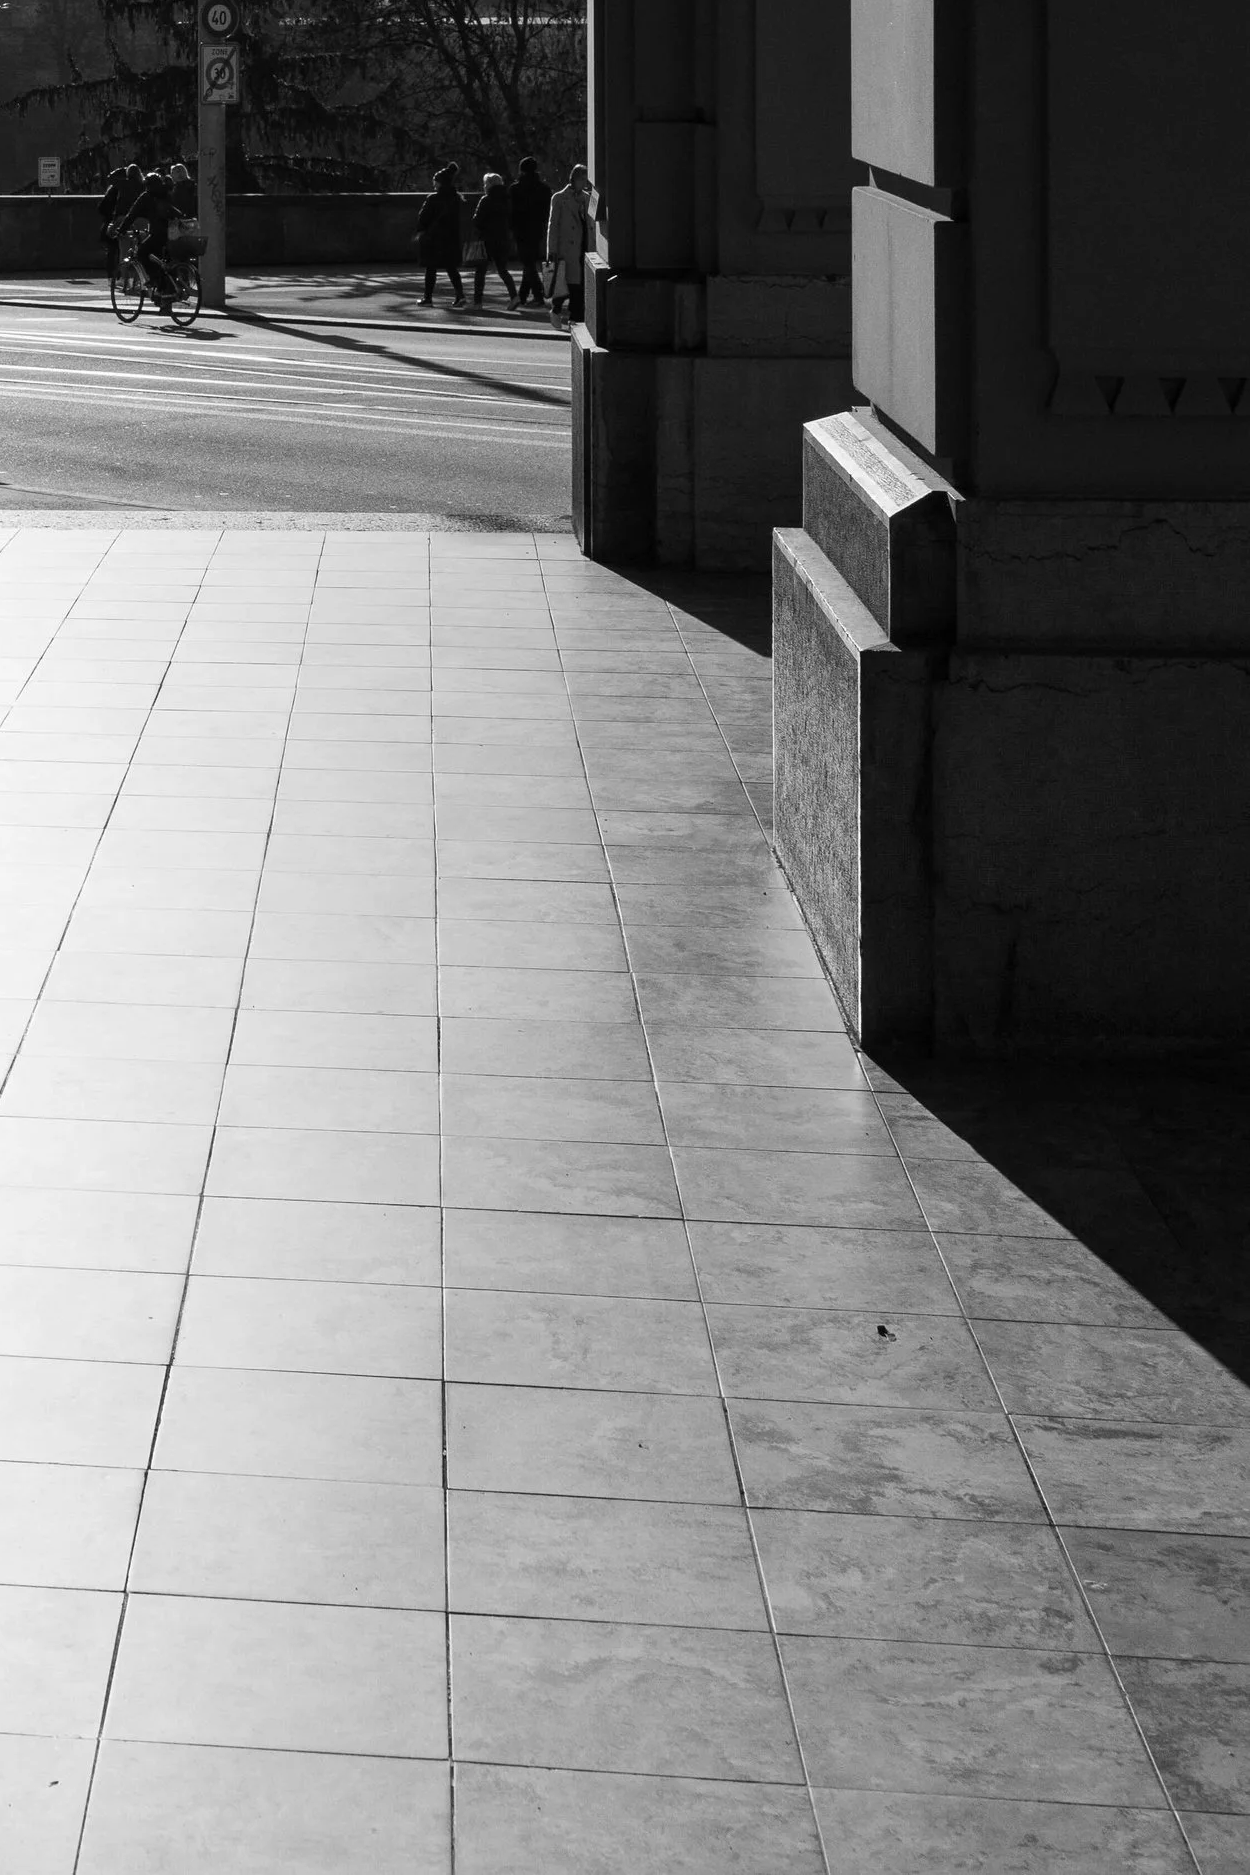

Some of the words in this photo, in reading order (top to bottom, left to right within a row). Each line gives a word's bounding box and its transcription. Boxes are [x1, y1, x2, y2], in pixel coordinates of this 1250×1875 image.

[212, 10, 227, 25] 40
[212, 48, 228, 56] ZONE
[214, 67, 226, 80] 30
